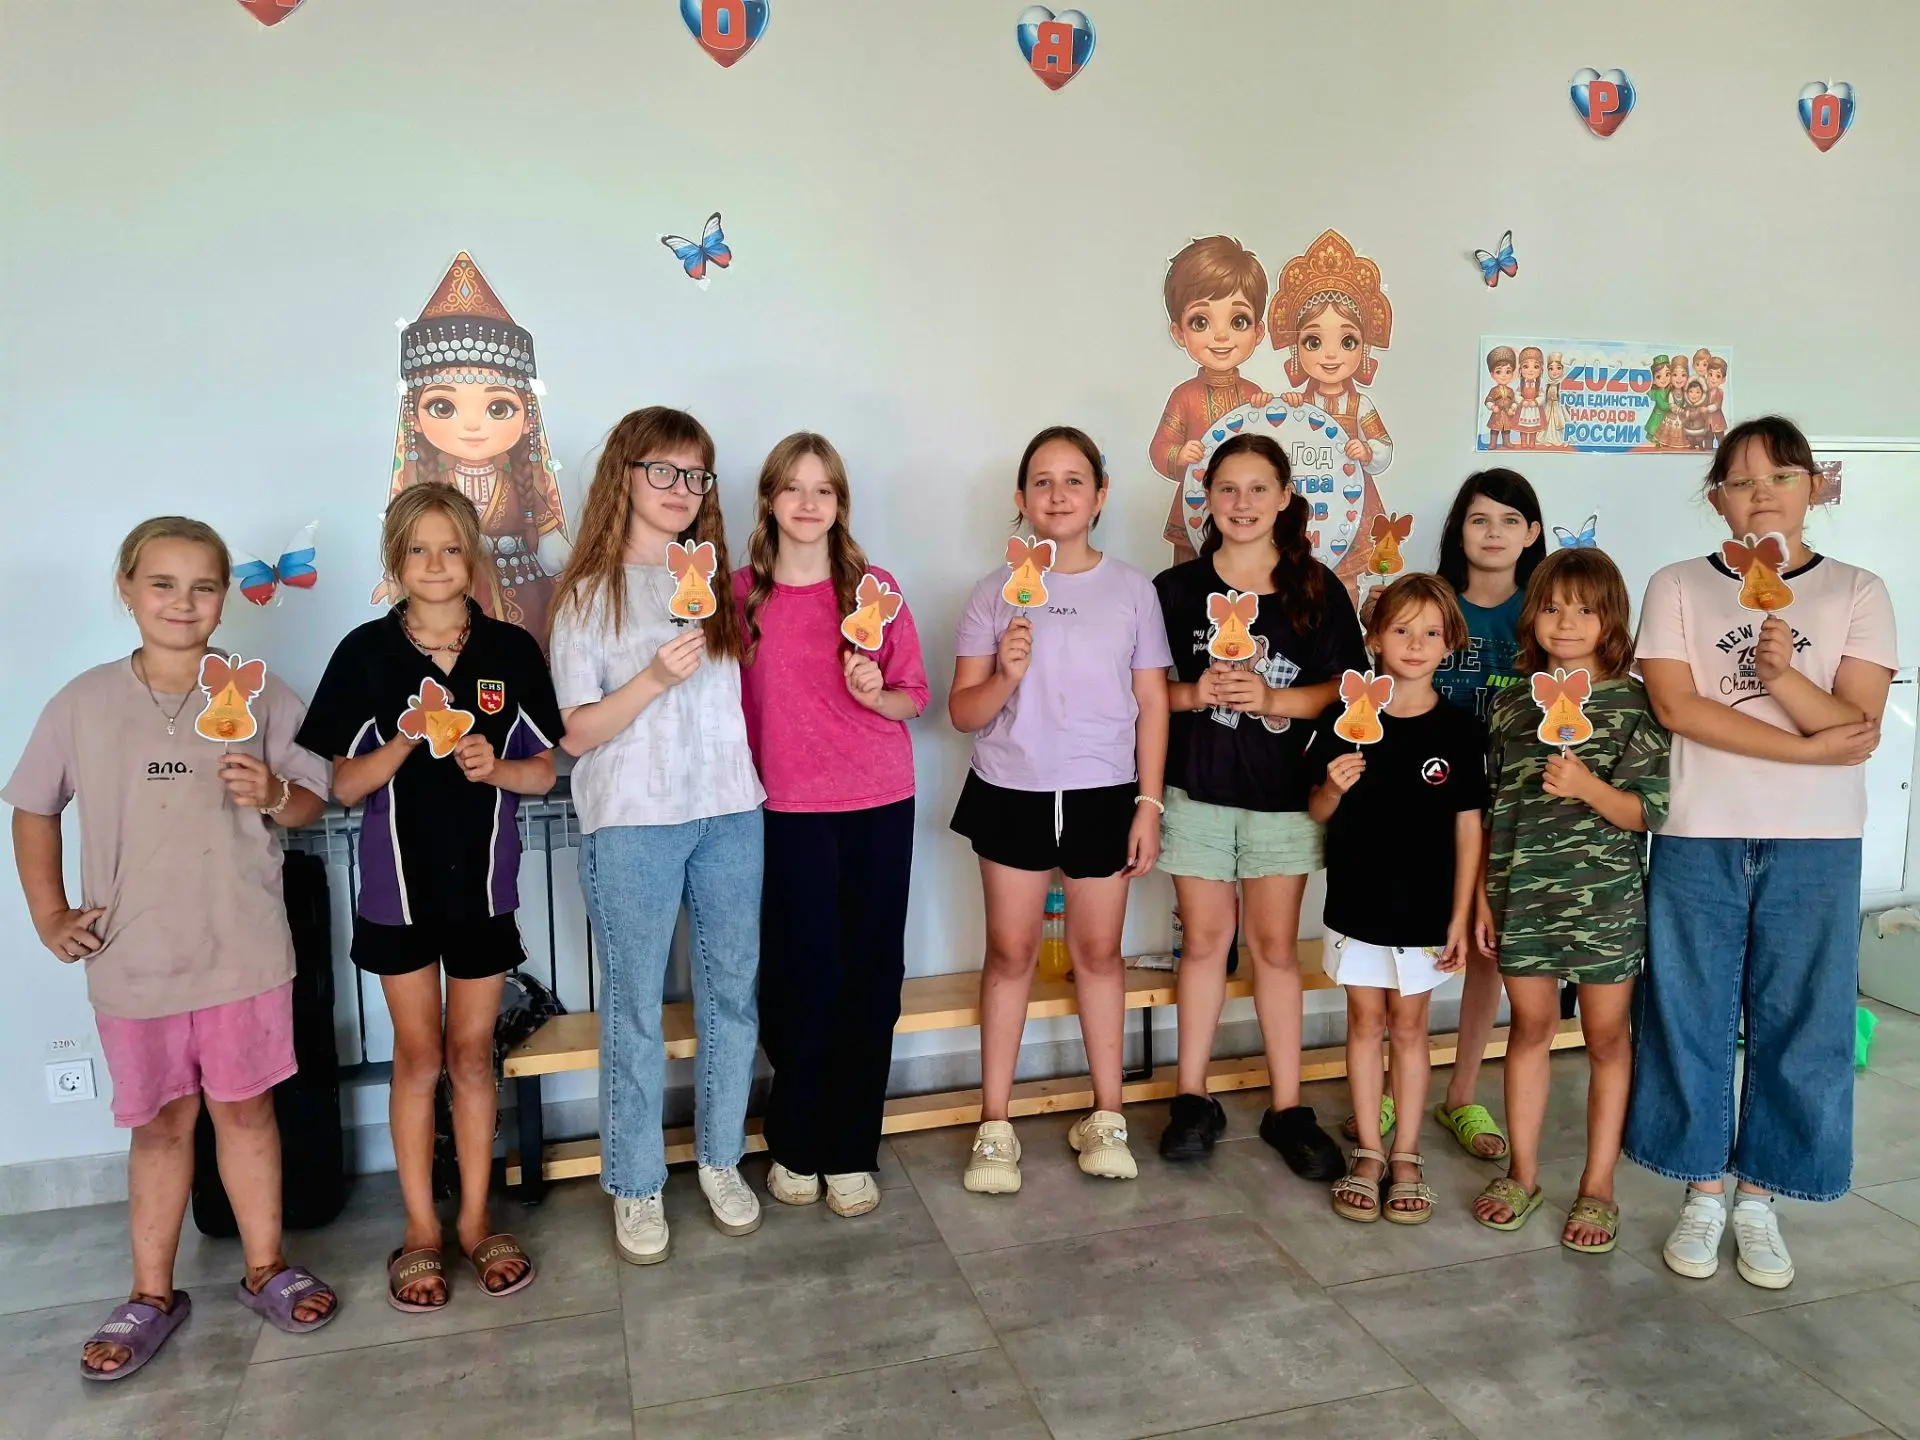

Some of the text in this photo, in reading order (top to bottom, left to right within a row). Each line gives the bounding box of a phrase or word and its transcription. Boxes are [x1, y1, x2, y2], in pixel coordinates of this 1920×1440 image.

[1031, 20, 1074, 74] Я
[1588, 80, 1620, 125] Р
[1810, 93, 1841, 139] О
[1561, 393, 1650, 409] ГОД ЕДИНСТВА
[1570, 408, 1636, 423] НАРОДОВ
[1563, 423, 1642, 444] РОССИИ
[1715, 624, 1754, 654] NEW
[481, 683, 502, 691] CHS
[52, 1039, 77, 1049] 220V
[399, 1260, 442, 1279] WORDS
